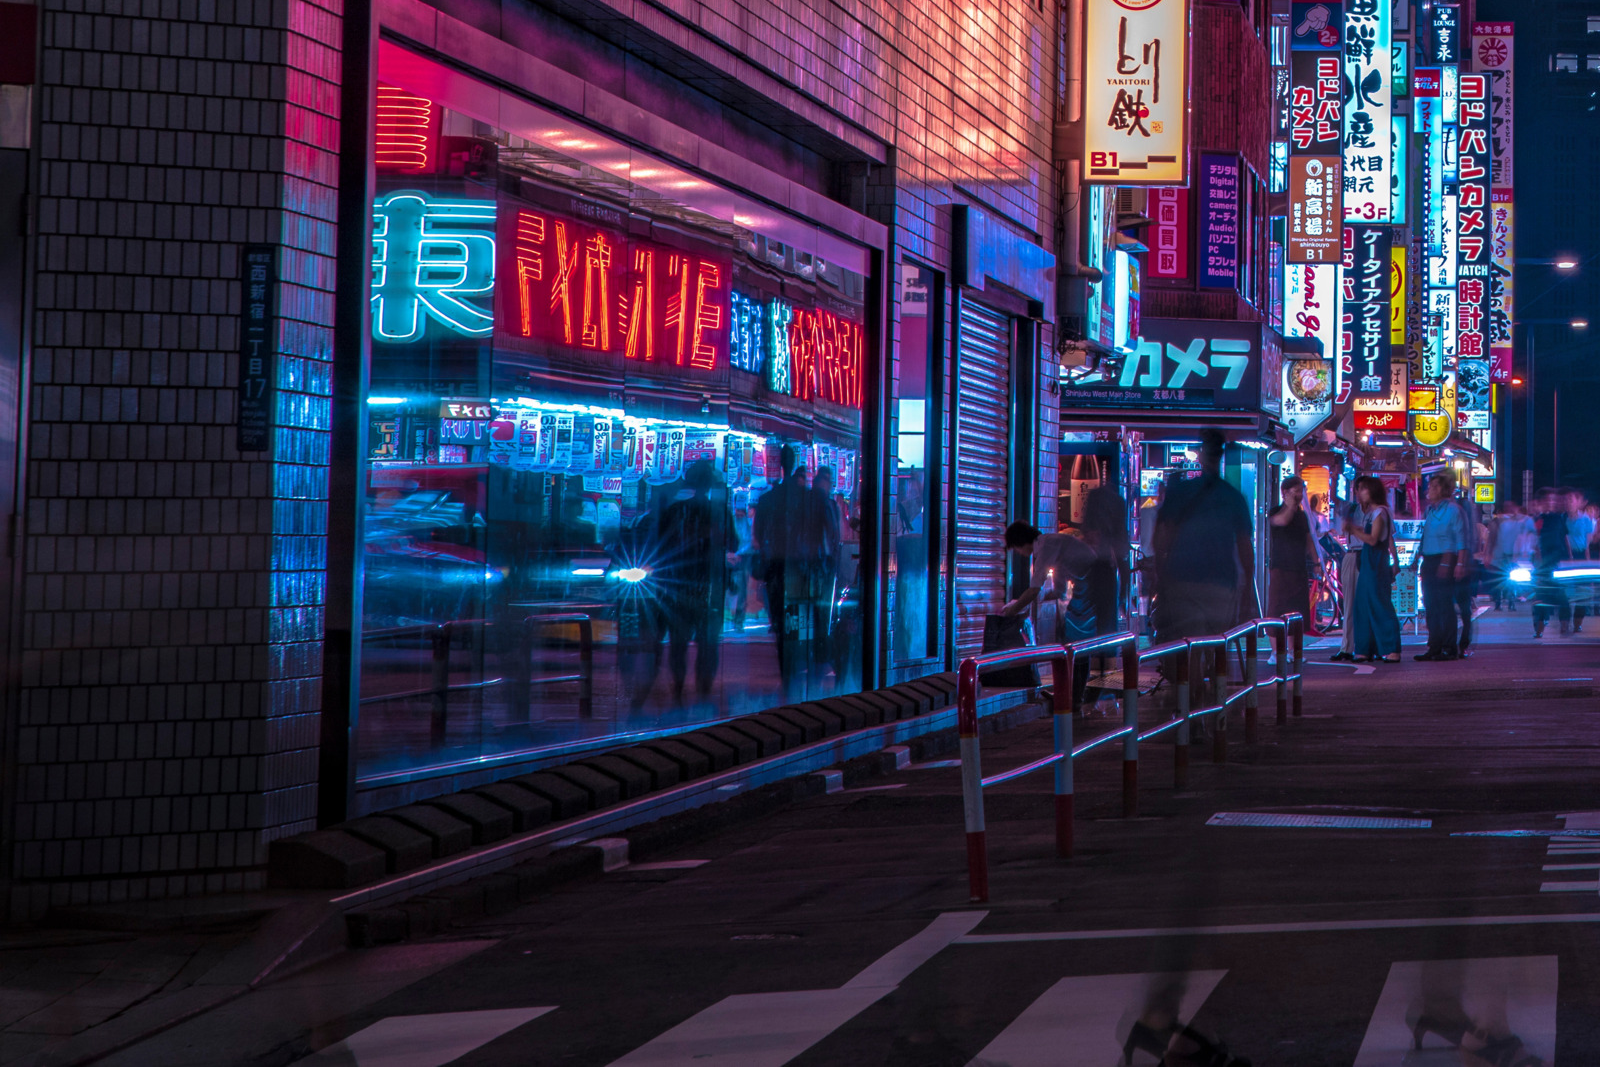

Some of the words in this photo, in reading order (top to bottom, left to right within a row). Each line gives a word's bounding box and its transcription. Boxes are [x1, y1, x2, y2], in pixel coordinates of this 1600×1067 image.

[1320, 31, 1337, 44] 2F
[1437, 28, 1452, 62] 吉永
[1317, 57, 1341, 142] ヨドバシ
[1292, 85, 1315, 149] カメラ
[1090, 151, 1118, 167] B1
[1459, 75, 1487, 262] ヨドバシカメラ
[1210, 177, 1234, 186] Digital
[1208, 235, 1236, 244] パソコン
[1495, 207, 1508, 258] きんくら
[1208, 246, 1219, 254] PC
[1208, 268, 1235, 277] Mobile
[248, 265, 266, 375] 西新宿一丁目
[1360, 229, 1383, 391] ケータイアクセサリー館
[1458, 279, 1484, 357] 時計館
[1118, 335, 1251, 390] カメラ
[243, 378, 267, 398] 17
[1065, 389, 1091, 399] Shinjuku
[1092, 390, 1107, 398] West
[1125, 391, 1141, 399] Store
